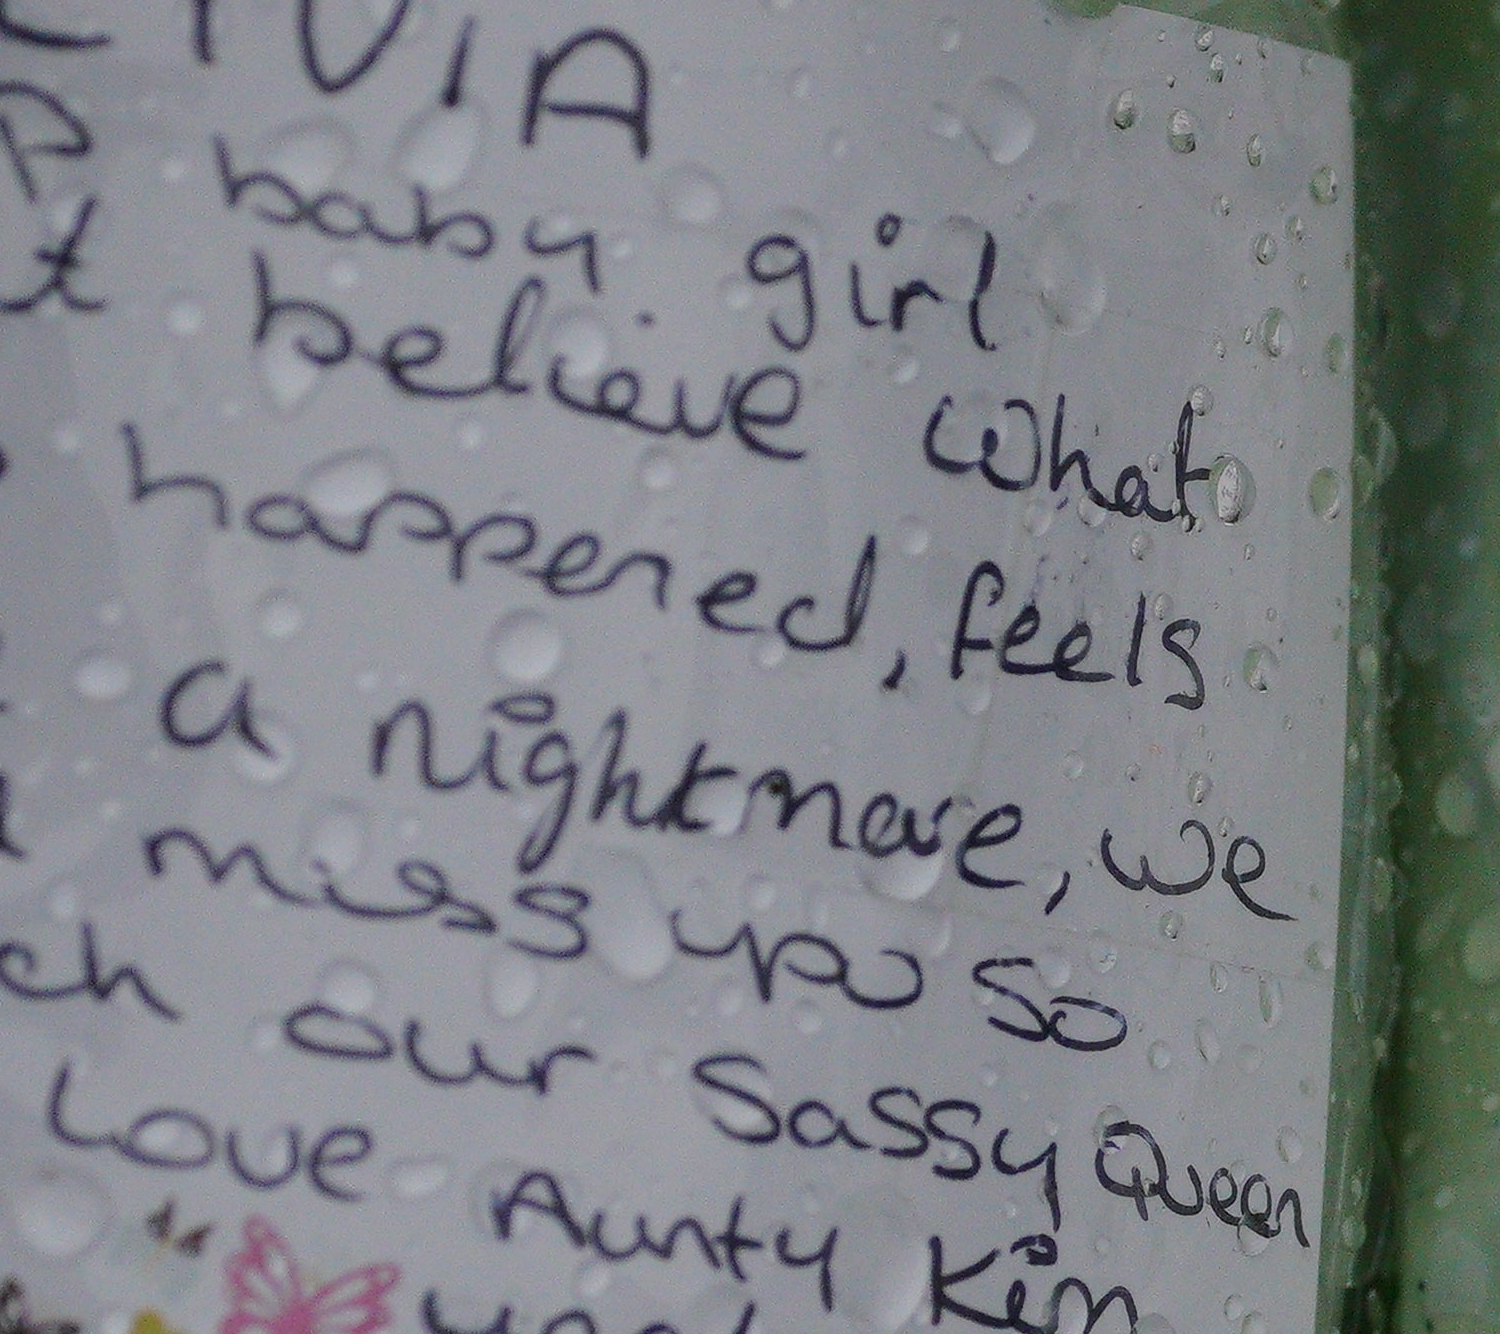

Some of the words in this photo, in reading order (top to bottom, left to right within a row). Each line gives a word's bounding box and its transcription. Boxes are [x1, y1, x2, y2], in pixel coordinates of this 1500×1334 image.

[213, 135, 603, 295] baby
[747, 212, 998, 351] girl
[255, 250, 805, 461] believe
[161, 659, 276, 761] a
[1099, 819, 1296, 922] we
[144, 827, 591, 959] miss
[672, 908, 924, 1004] you
[46, 1060, 375, 1202] Love
[493, 1171, 842, 1311] Aunty
[284, 1003, 599, 1095] our
[1094, 1119, 1310, 1248] Queen
